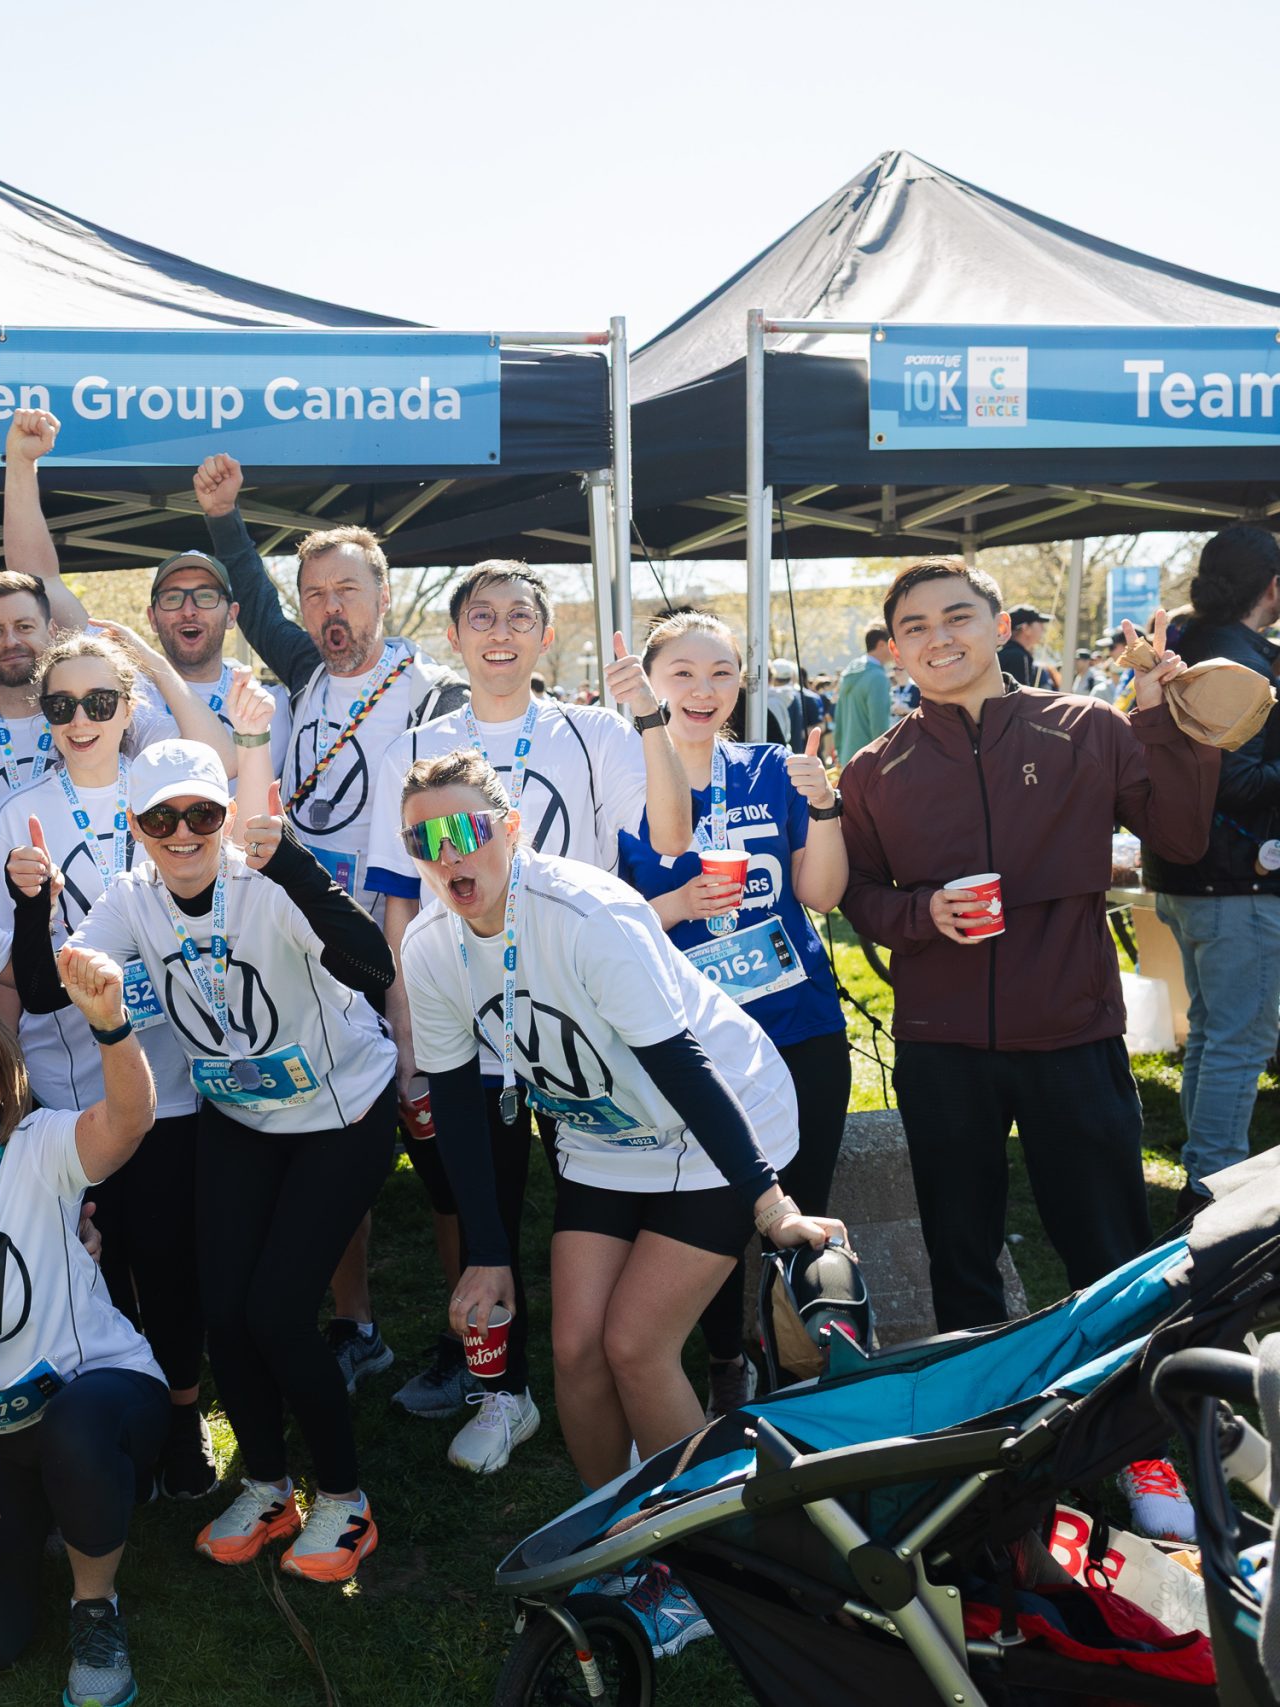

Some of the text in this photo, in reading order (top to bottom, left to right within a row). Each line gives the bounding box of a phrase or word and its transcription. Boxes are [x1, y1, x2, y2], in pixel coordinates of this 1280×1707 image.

[904, 371, 962, 411] 10K
[1124, 360, 1280, 418] Team
[72, 375, 244, 428] Group
[263, 376, 461, 420] Canada
[976, 405, 1020, 417] CIRCLE
[743, 803, 773, 821] 10K
[743, 877, 770, 894] ARS
[214, 918, 220, 928] 25
[710, 916, 734, 932] 10K
[185, 942, 195, 960] 2025
[706, 951, 729, 962] YEARS
[703, 949, 768, 983] 0162
[125, 981, 155, 1005] 52
[131, 1004, 156, 1015] TIANA
[204, 1073, 277, 1094] 1196
[628, 1137, 654, 1146] 14922
[466, 1340, 507, 1367] ortons
